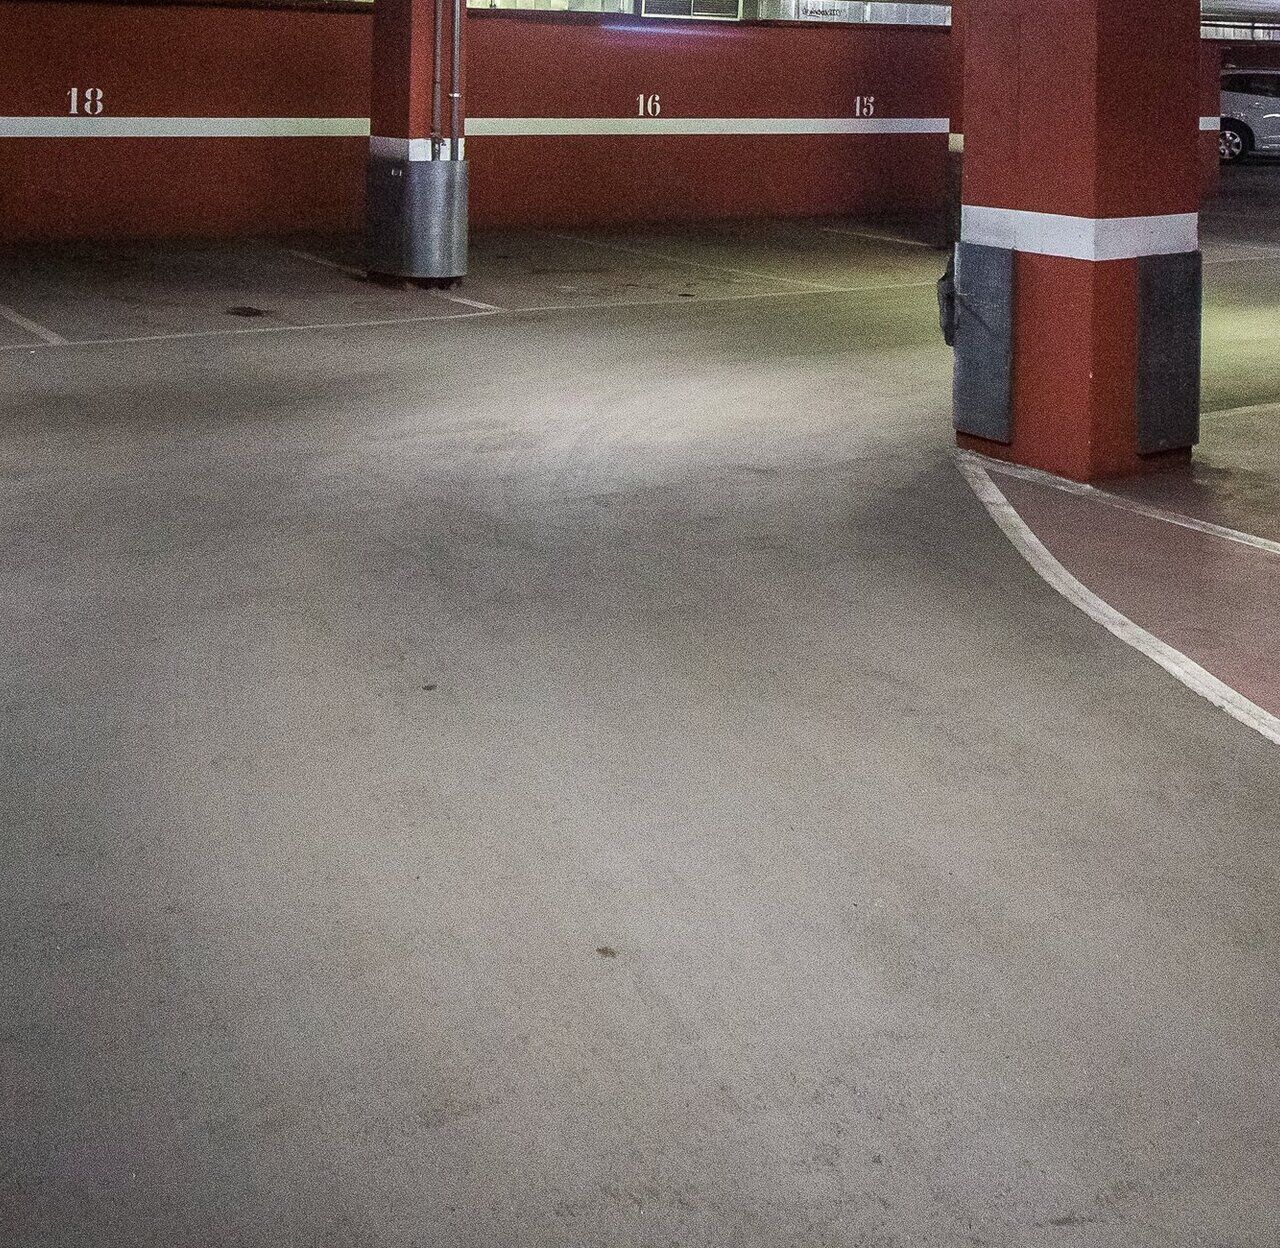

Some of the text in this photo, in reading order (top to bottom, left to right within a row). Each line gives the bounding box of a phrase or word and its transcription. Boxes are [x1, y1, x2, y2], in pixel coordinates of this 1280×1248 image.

[67, 87, 104, 115] 18
[636, 93, 661, 117] 16
[853, 95, 875, 117] 15
